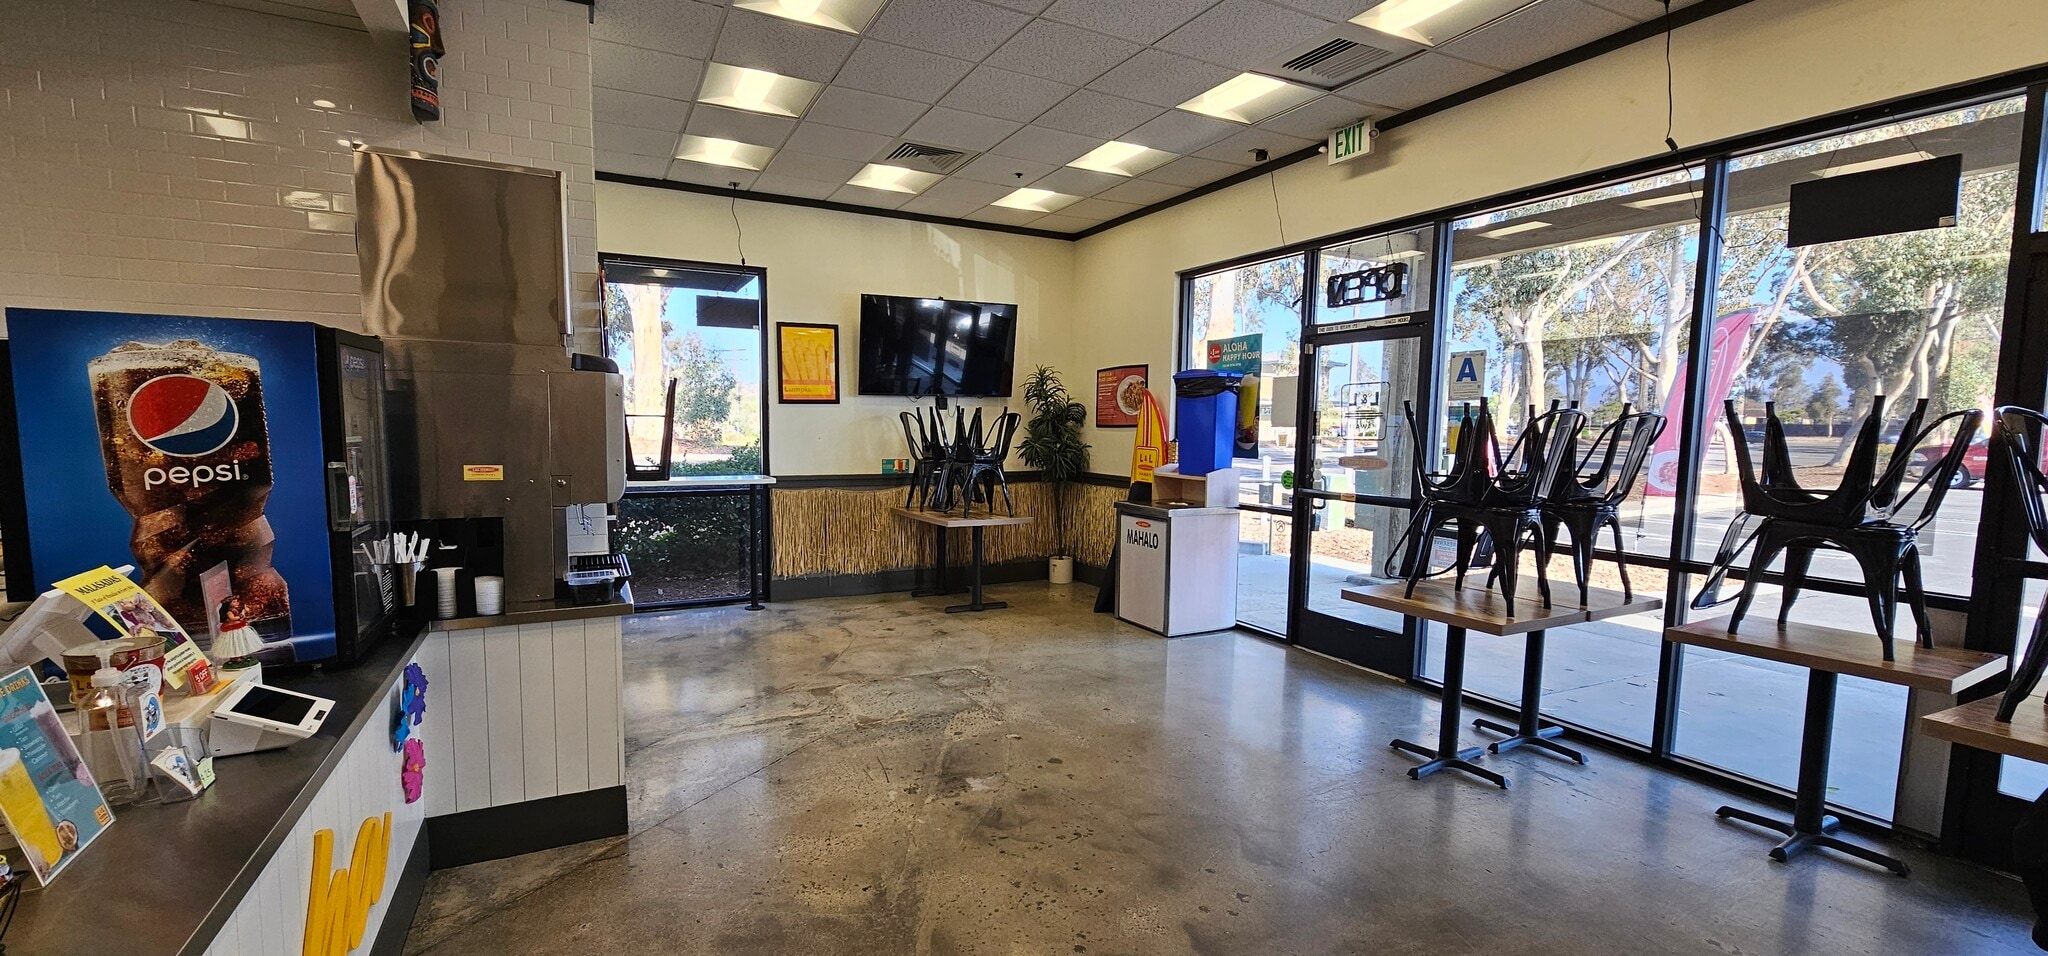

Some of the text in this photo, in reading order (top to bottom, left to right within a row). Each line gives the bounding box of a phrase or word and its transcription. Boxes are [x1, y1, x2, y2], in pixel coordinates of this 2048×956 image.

[1336, 122, 1365, 159] EXIT
[1222, 353, 1241, 362] HAPPY
[1242, 351, 1261, 360] HOUR
[1223, 341, 1248, 353] ALOHA
[1456, 357, 1478, 382] A
[784, 386, 812, 394] Lumpia
[143, 460, 242, 490] pepsi
[1127, 528, 1159, 549] MAHALO
[75, 575, 122, 596] MALASADAS
[5, 676, 30, 694] DRINKS
